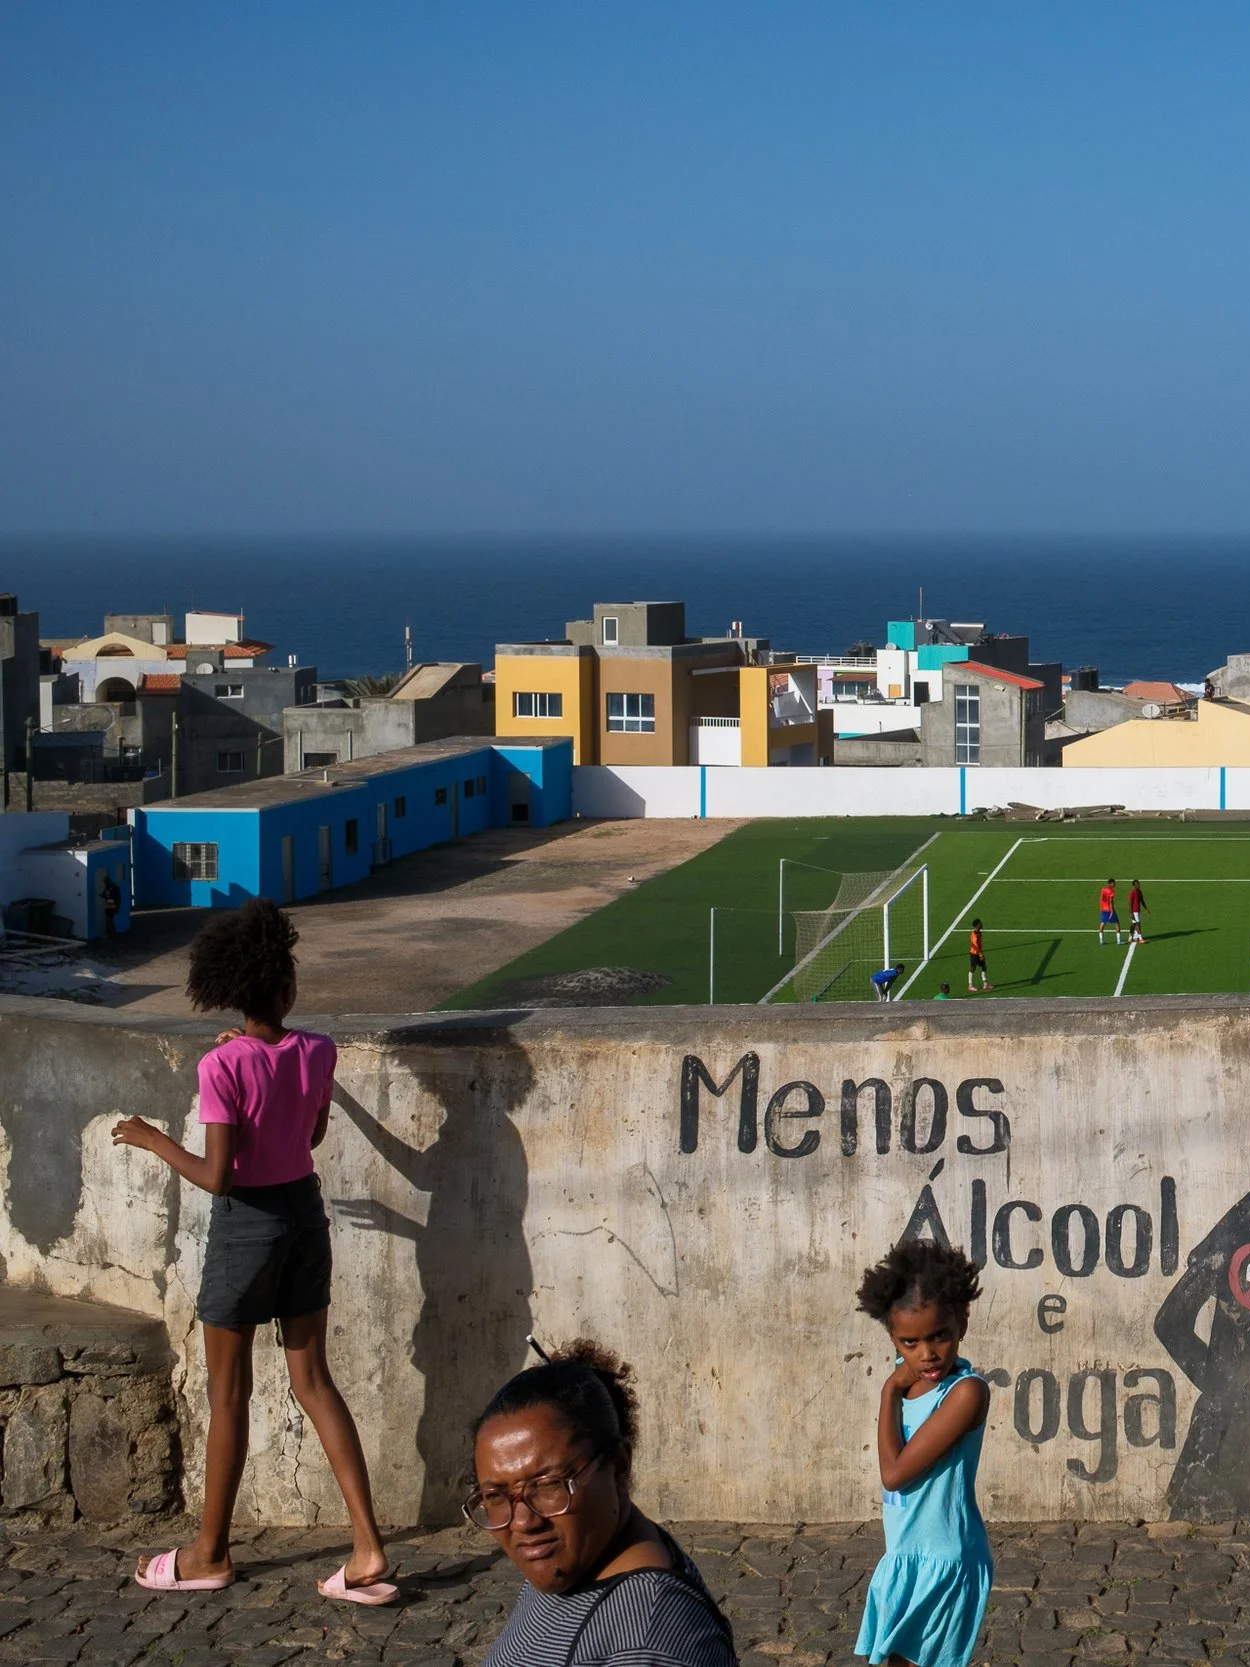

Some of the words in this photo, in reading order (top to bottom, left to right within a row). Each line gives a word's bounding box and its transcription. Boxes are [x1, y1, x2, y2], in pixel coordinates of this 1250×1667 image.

[680, 1051, 1011, 1158] Menos
[894, 1157, 1179, 1278] Álcool
[1037, 1292, 1068, 1335] e
[896, 1351, 1177, 1484] roga
